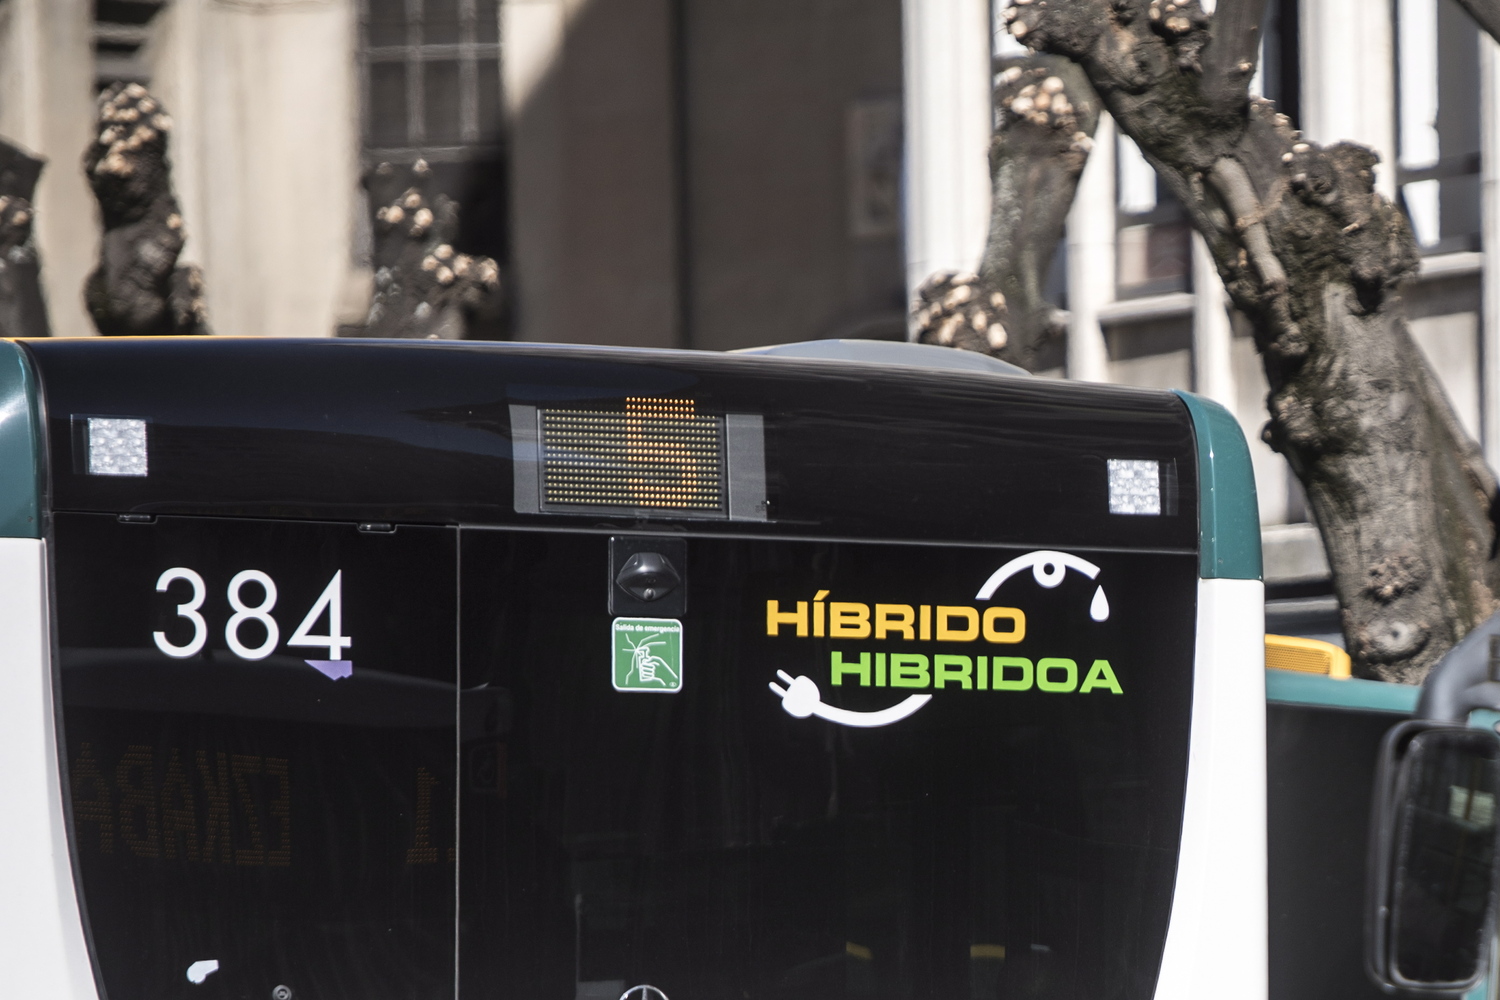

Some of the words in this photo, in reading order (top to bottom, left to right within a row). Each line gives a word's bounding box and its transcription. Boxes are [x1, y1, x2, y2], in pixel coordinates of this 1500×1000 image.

[625, 396, 697, 507] 5
[153, 567, 353, 660] 384
[615, 623, 635, 632] Salida
[635, 624, 644, 632] de
[644, 625, 680, 634] emergencia
[767, 590, 1026, 644] HÍBRIDO
[831, 651, 1124, 695] HIBRIDOA
